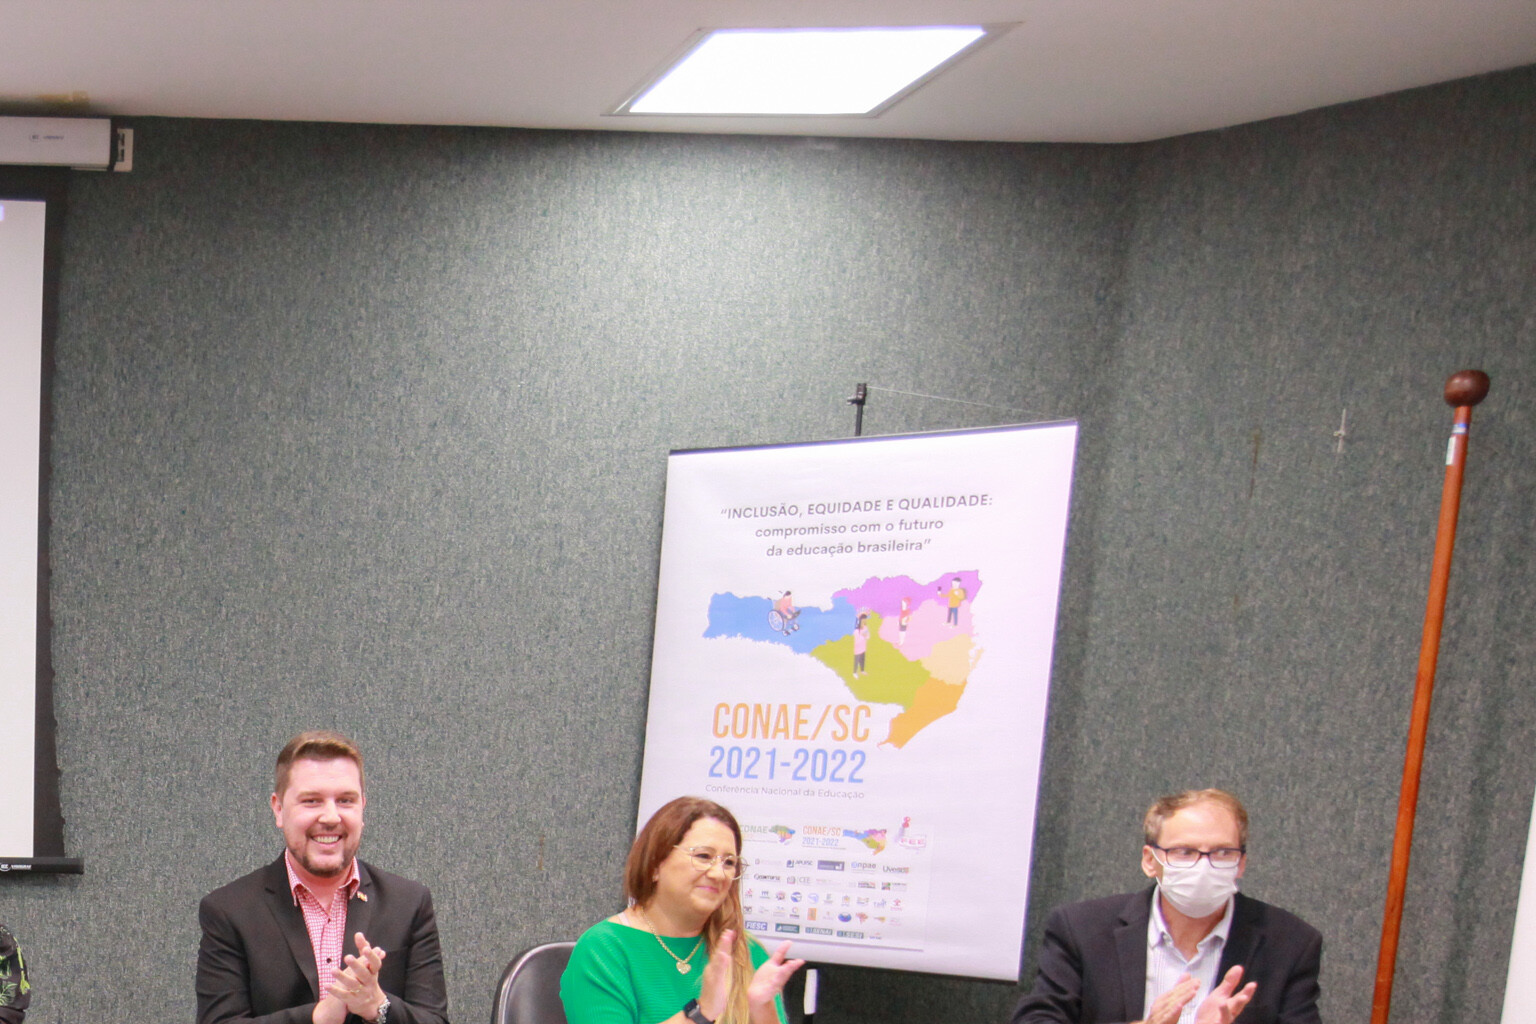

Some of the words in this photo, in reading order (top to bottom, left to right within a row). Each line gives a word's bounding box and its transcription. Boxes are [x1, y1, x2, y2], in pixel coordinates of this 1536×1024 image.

[808, 499, 882, 515] EQUIDADE
[886, 499, 894, 511] E
[898, 494, 993, 511] QUALIDADE:
[755, 523, 847, 539] compromisso
[850, 523, 881, 533] com
[885, 522, 894, 532] o
[898, 519, 944, 531] futuro
[766, 545, 782, 557] da
[786, 543, 853, 557] educação
[857, 538, 931, 553] brasileira”
[712, 702, 872, 742] CONAE/SC
[708, 745, 867, 783] 2021-2022
[705, 784, 759, 794] Conferência
[761, 786, 802, 796] Nacional
[803, 788, 815, 797] da
[817, 788, 865, 799] Educação
[802, 825, 841, 836] CONAE/SC
